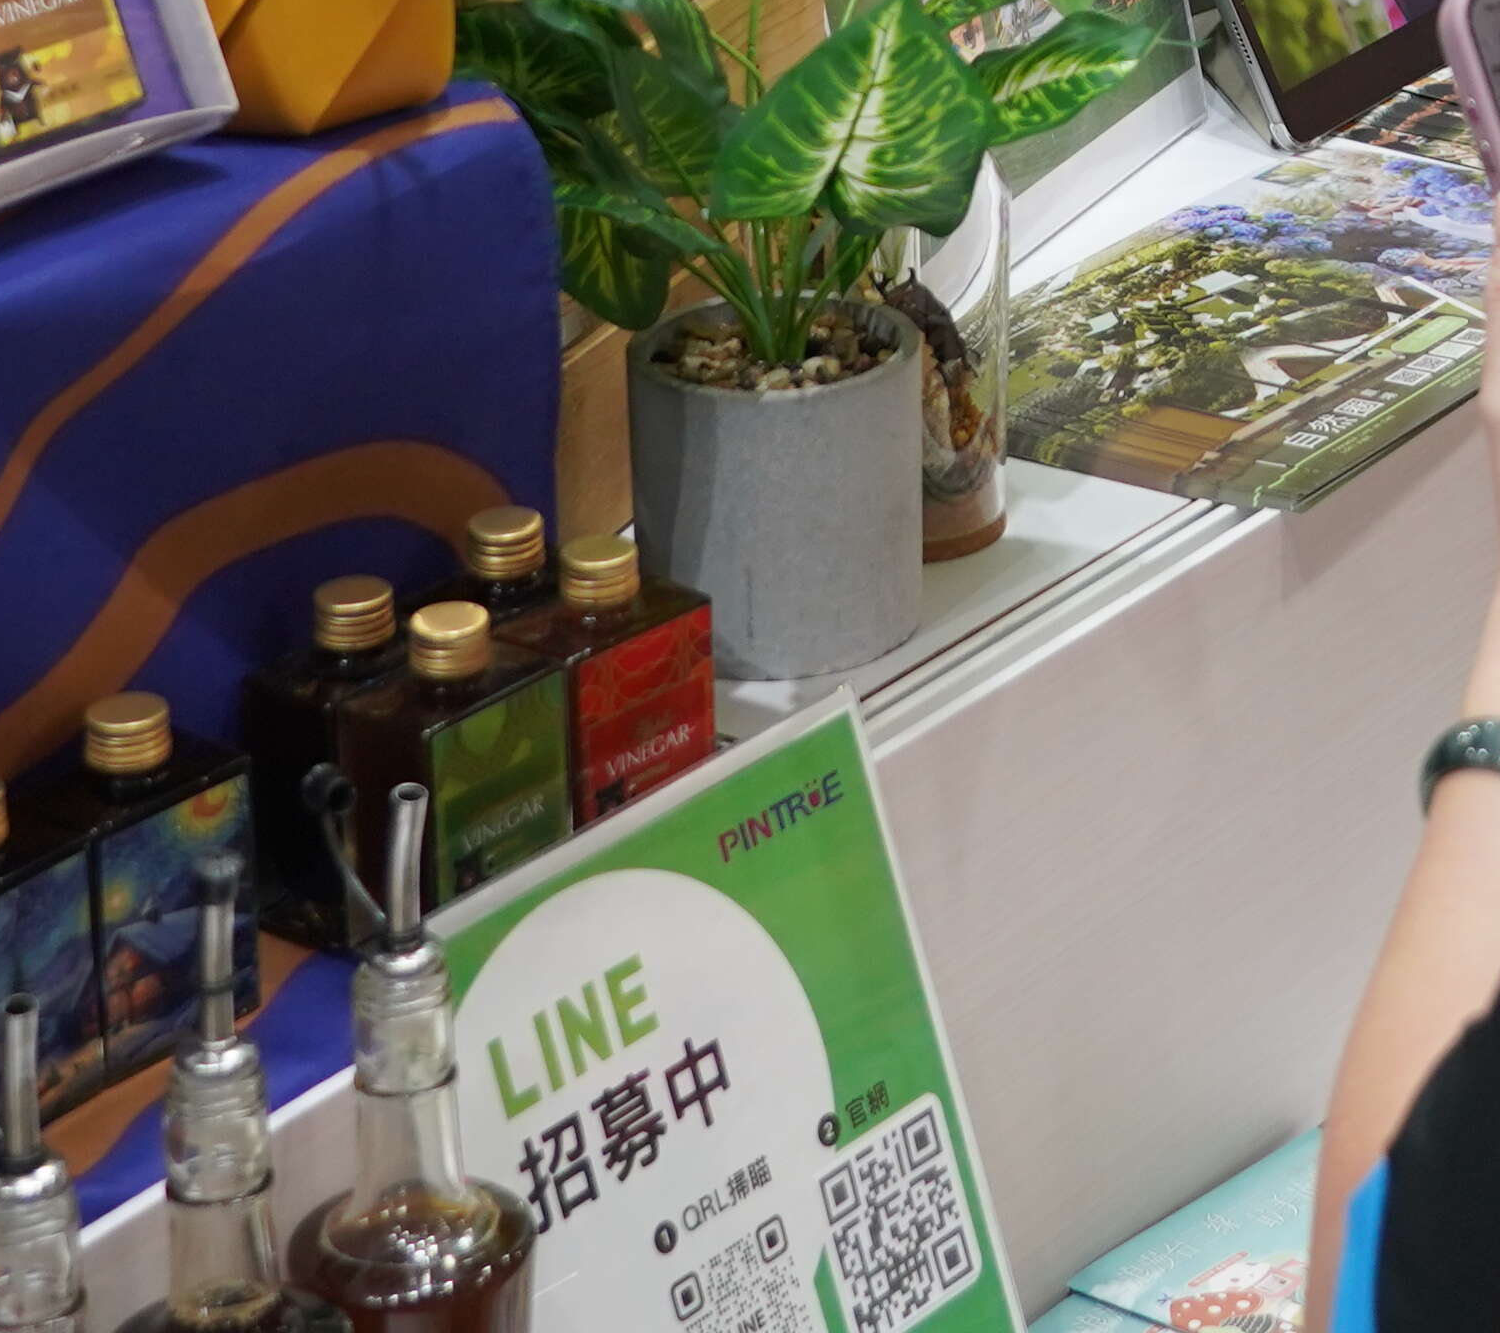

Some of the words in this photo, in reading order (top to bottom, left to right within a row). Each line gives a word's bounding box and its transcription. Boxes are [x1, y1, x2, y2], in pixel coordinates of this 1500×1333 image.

[604, 723, 695, 778] VINEGAR
[487, 954, 661, 1119] LINE
[517, 1037, 731, 1234] 招募中
[845, 1080, 891, 1130] 官網
